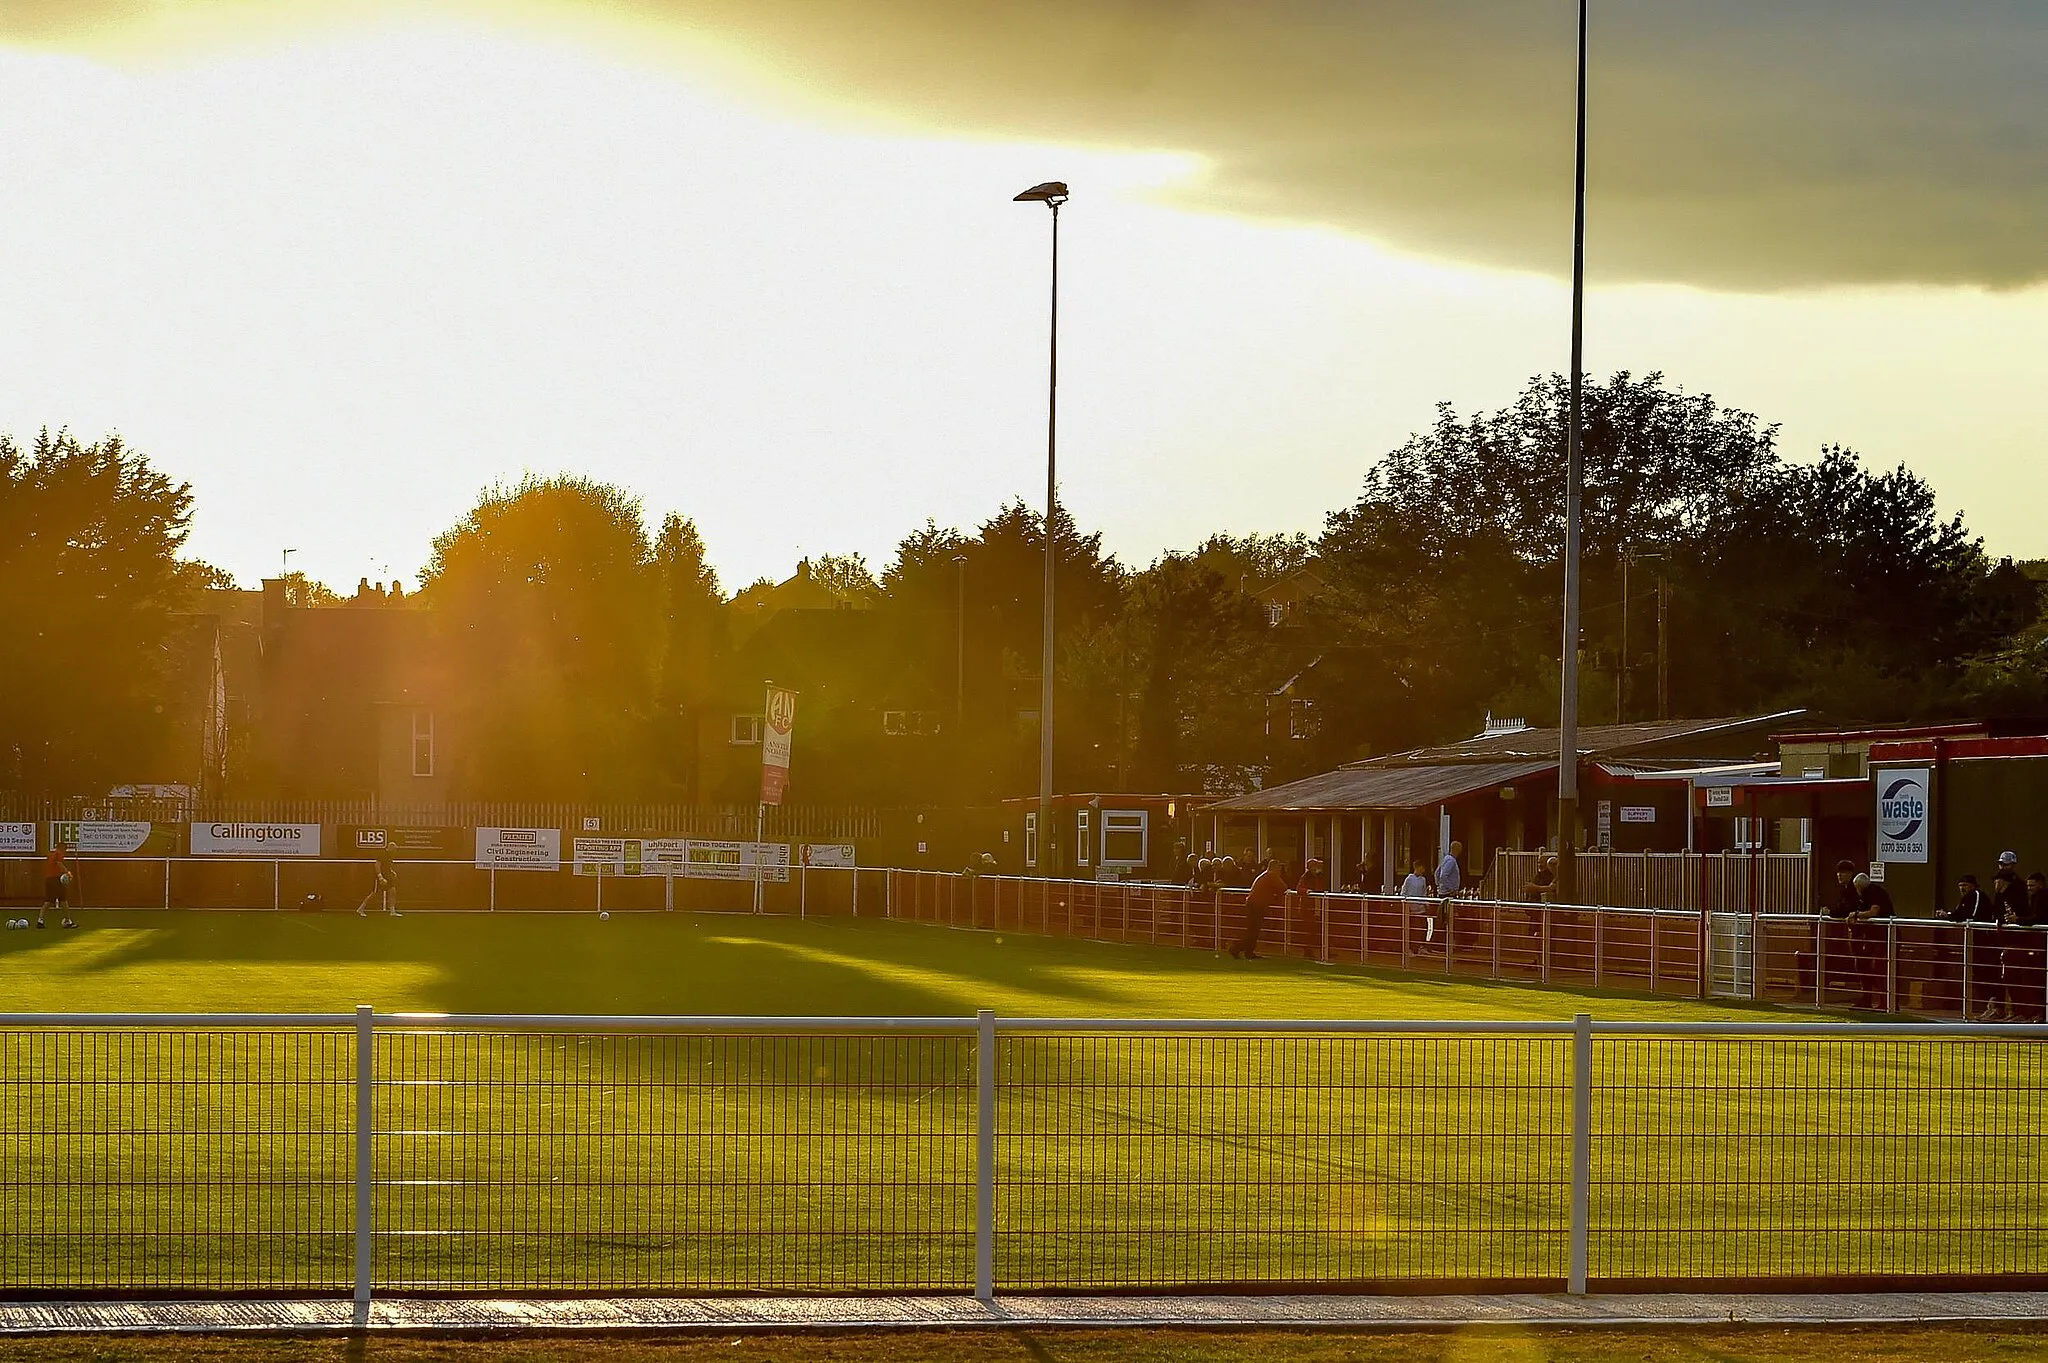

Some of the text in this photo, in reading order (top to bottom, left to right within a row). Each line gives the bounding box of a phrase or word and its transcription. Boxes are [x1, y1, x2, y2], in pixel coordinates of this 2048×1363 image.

[1882, 797, 1923, 818] waste
[211, 824, 302, 842] Callingtons
[359, 832, 384, 843] LBS
[505, 849, 549, 857] Engineering
